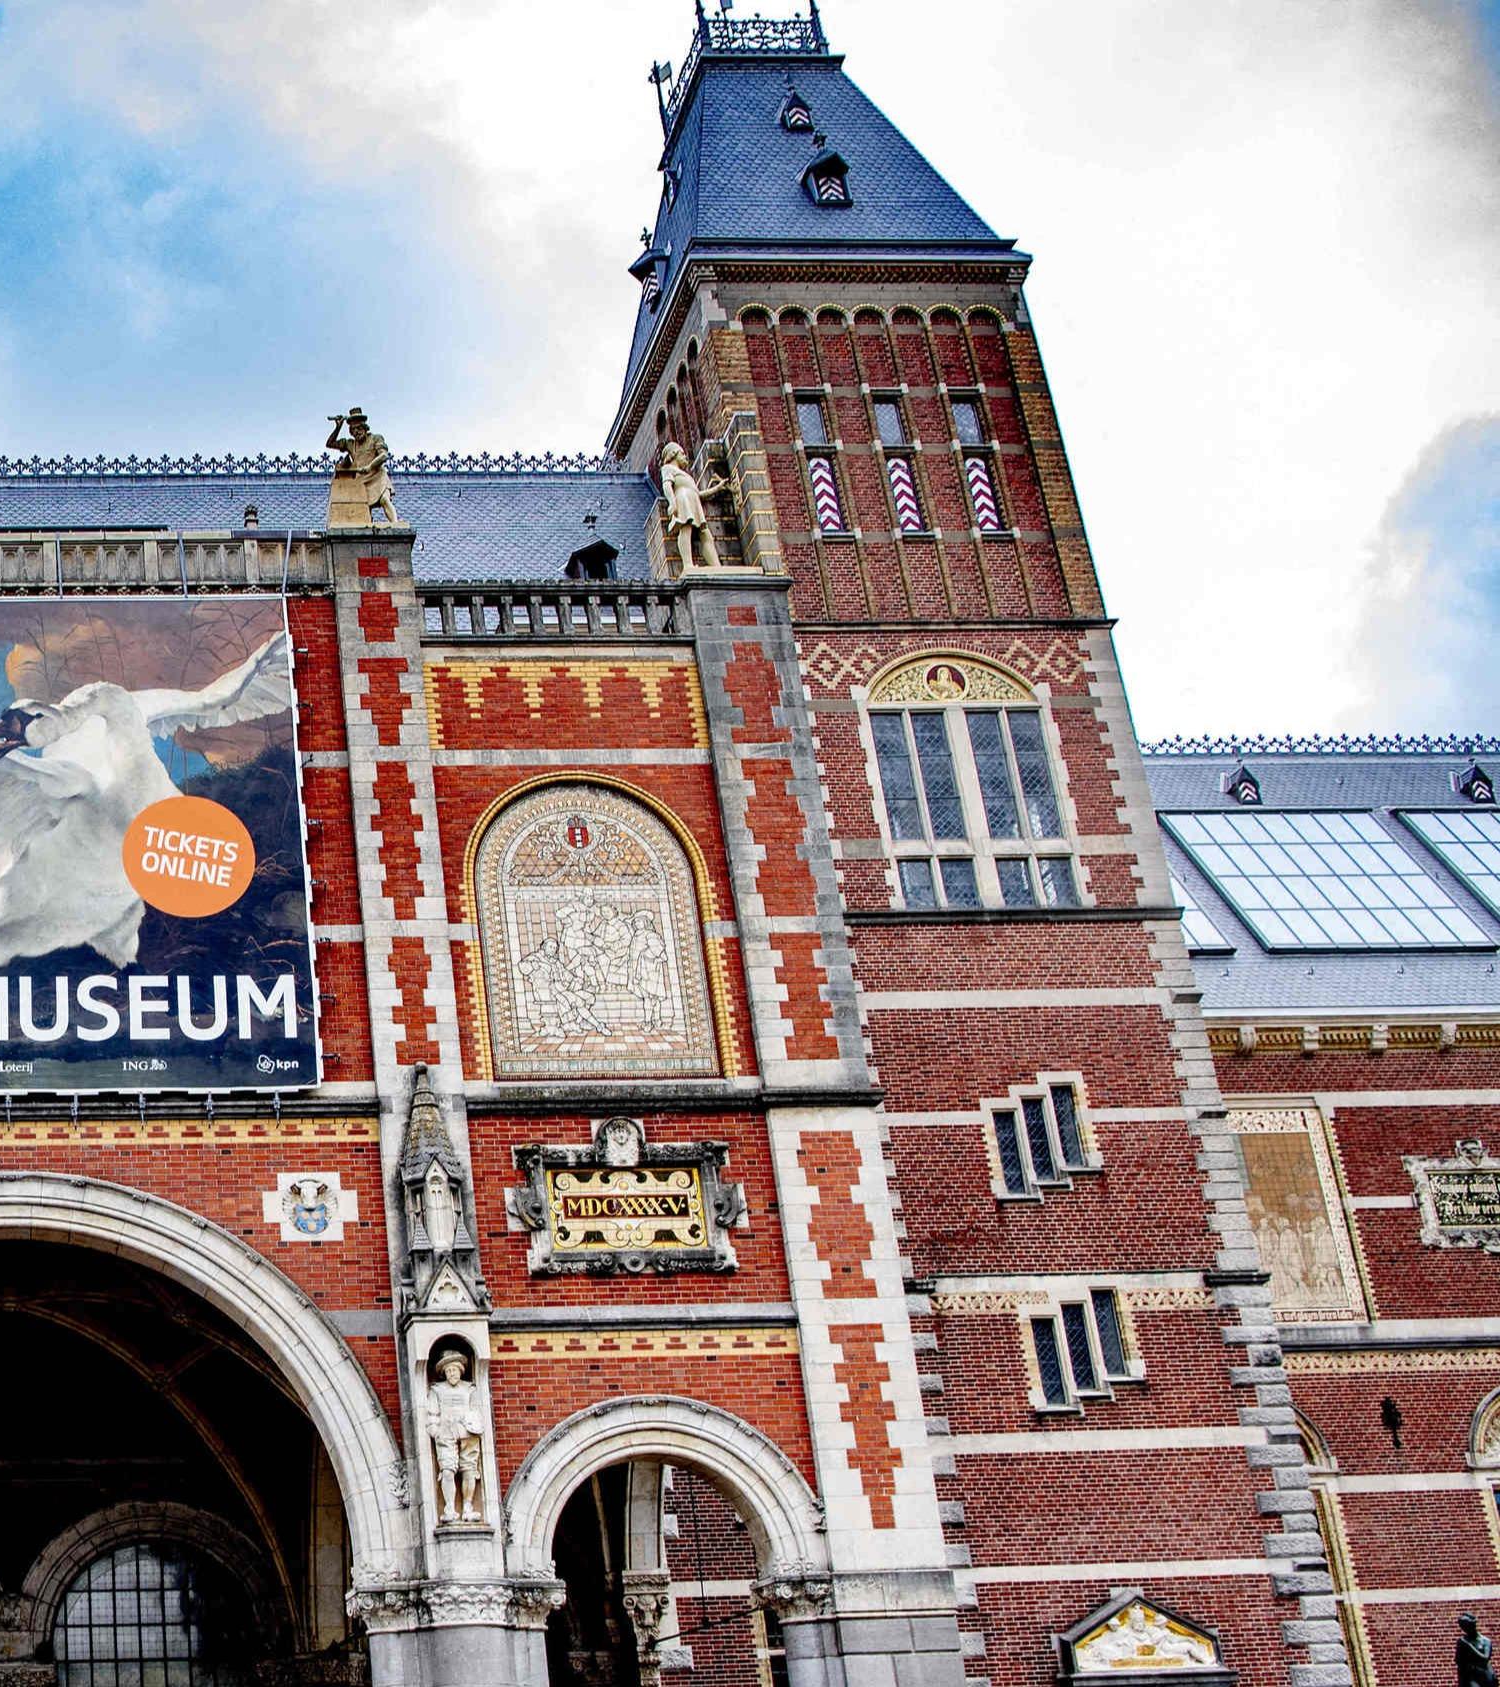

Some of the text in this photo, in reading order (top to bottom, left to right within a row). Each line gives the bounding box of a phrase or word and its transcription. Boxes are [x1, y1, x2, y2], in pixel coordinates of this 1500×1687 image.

[144, 825, 239, 863] TICKETS
[141, 851, 233, 888] ONLINE
[122, 1060, 149, 1071] ING
[276, 1059, 300, 1071] kpn
